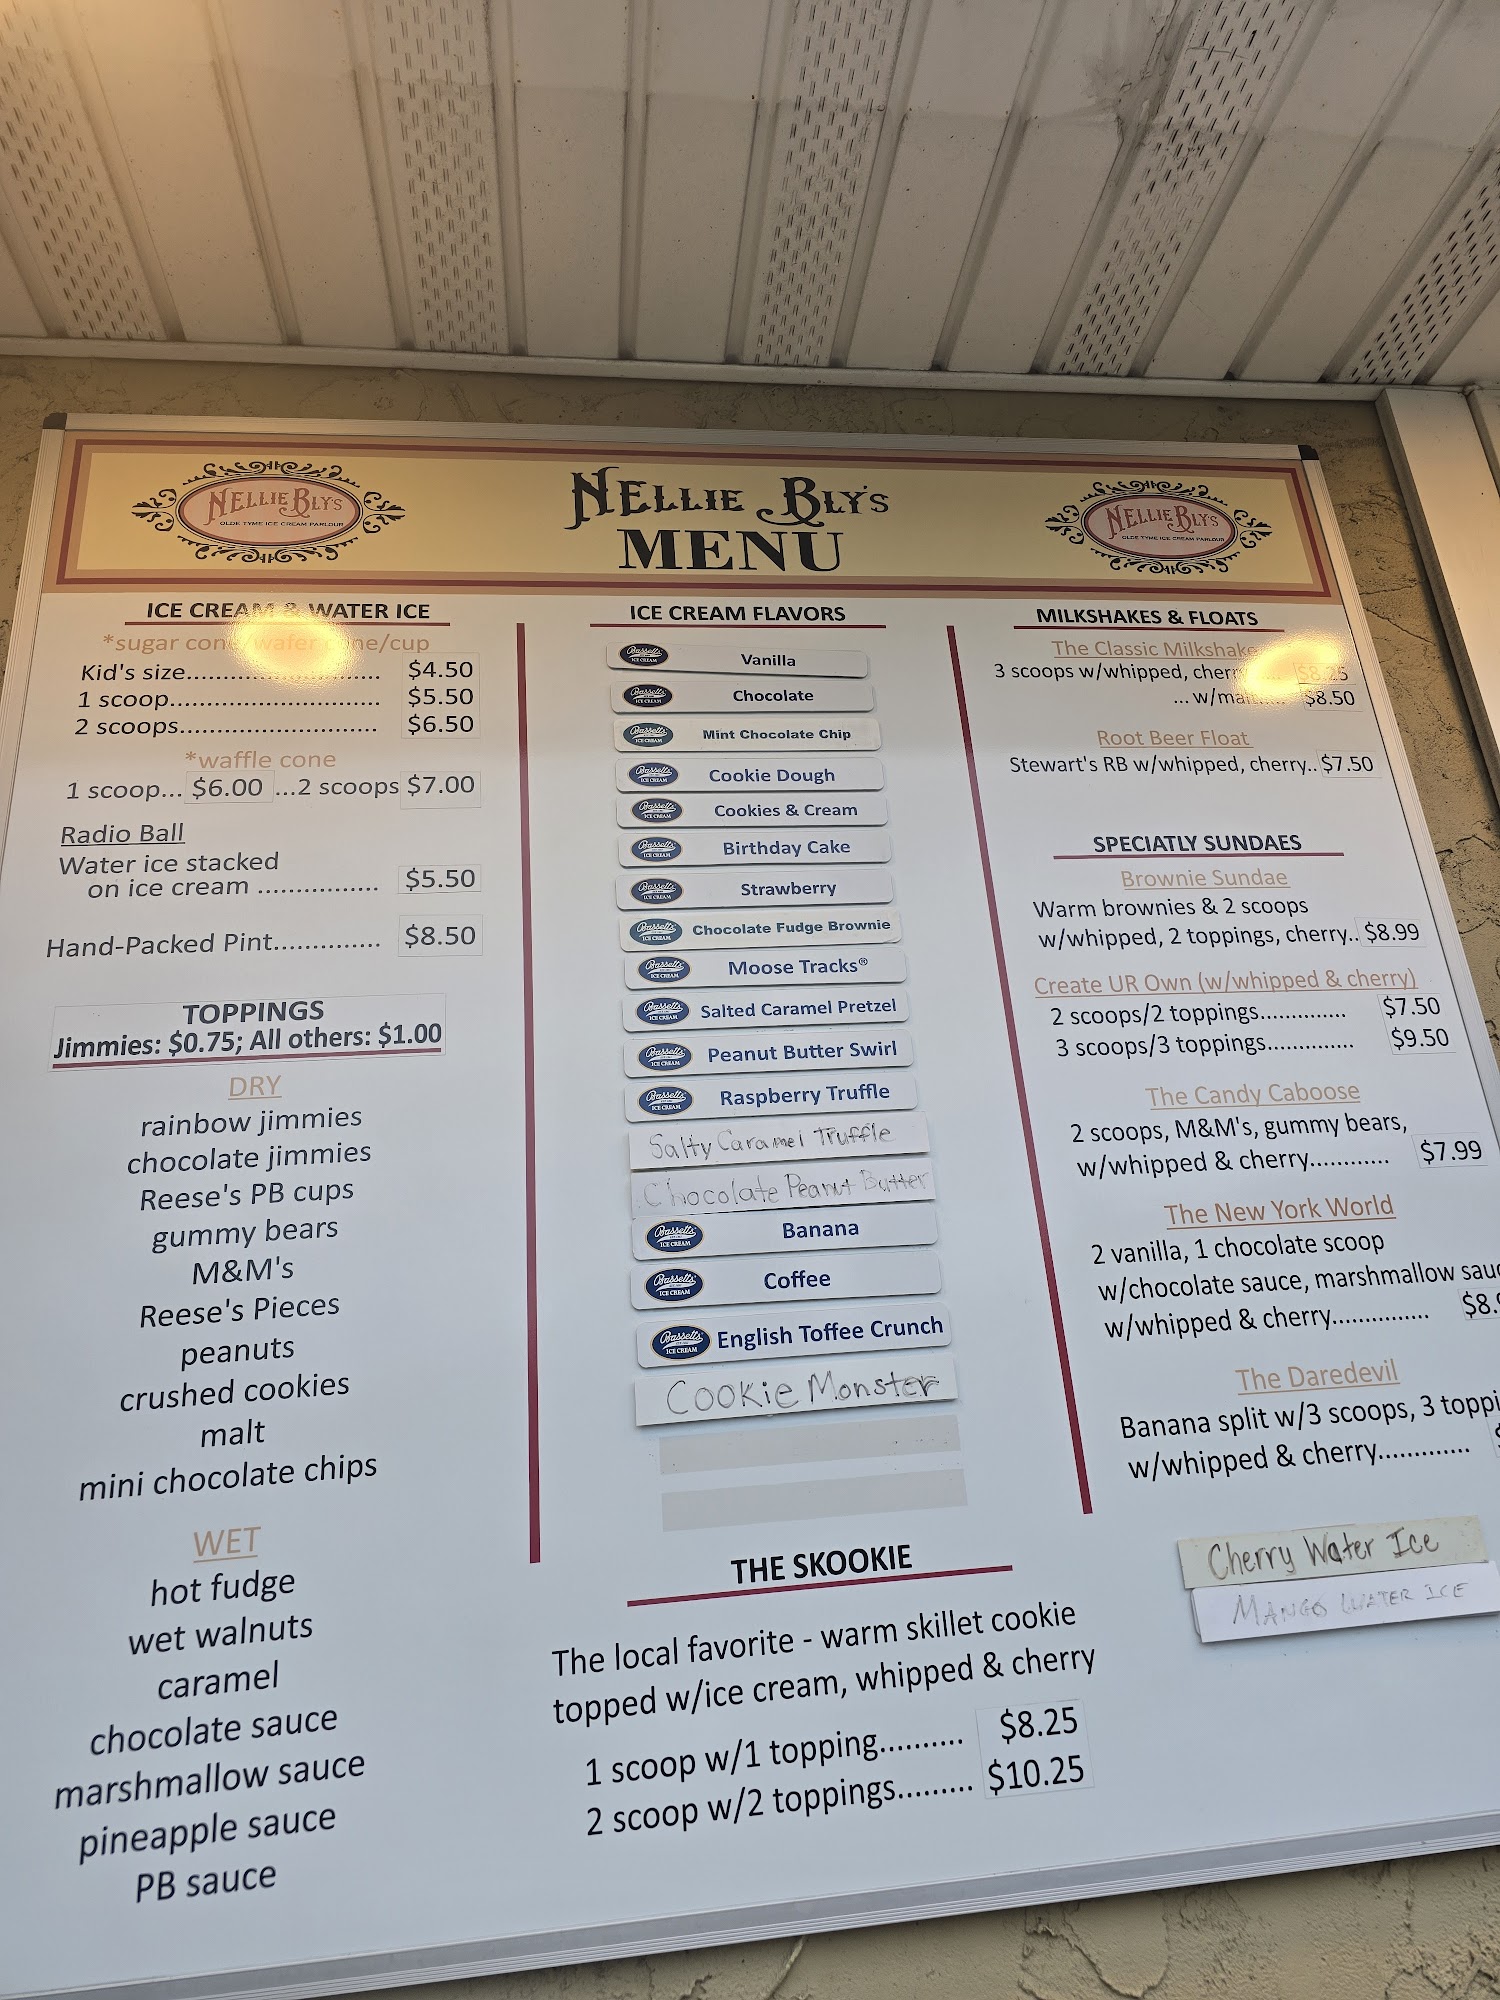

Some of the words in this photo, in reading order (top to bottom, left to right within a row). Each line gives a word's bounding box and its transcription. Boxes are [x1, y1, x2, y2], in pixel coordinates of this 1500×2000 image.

[617, 529, 844, 572] MENU
[146, 603, 184, 619] ICE
[189, 603, 275, 619] CREAM
[308, 603, 390, 619] WATER
[395, 603, 430, 619] ICE
[630, 605, 662, 620] ICE
[668, 605, 746, 621] CREAM
[753, 606, 846, 622] FLAVORS
[1036, 608, 1162, 624] MILKSHAKES
[1168, 610, 1184, 625] &
[1189, 610, 1258, 626] FLOATS
[407, 659, 474, 680] $4.50
[740, 653, 797, 667] Vanilla
[407, 686, 474, 708] $5.50
[732, 689, 814, 702] Chocolate
[407, 714, 475, 735] $6.50
[702, 729, 735, 740] Mint
[739, 729, 814, 740] Chocolate
[819, 729, 851, 740] Chip
[1097, 730, 1145, 747] Root
[1150, 730, 1195, 747] Beer
[1200, 730, 1250, 747] Float
[279, 753, 337, 769] cone
[708, 768, 771, 783] Cookie
[776, 768, 835, 786] Dough
[714, 803, 781, 817] Cookies
[785, 803, 799, 817] &
[803, 803, 858, 817] Cream
[60, 824, 131, 844] Radio
[139, 823, 185, 843] Ball
[1093, 836, 1197, 853] SPECIATLY
[1205, 835, 1302, 851] SUNDAES
[723, 840, 802, 858] Birthday
[807, 839, 851, 855] Cake
[405, 868, 476, 890] $5.50
[740, 881, 837, 897] Strawberry
[1121, 870, 1207, 888] Brownie
[1212, 869, 1288, 886] Sundae
[1033, 900, 1097, 918] Warm
[1102, 898, 1196, 916] brownies
[1202, 898, 1218, 915] &
[1224, 898, 1236, 915] 2
[1241, 898, 1309, 918] scoops
[404, 925, 477, 947] $8.50
[692, 923, 772, 936] Chocolate
[776, 921, 823, 935] Fudge
[828, 919, 891, 932] Brownie
[1364, 922, 1420, 942] $8.99
[728, 960, 794, 976] Moose
[184, 1000, 325, 1025] TOPPINGS
[700, 1003, 756, 1019] Salted
[760, 1000, 833, 1017] Caramel
[837, 998, 897, 1014] Pretzel
[1382, 996, 1441, 1017] $7.50
[53, 1035, 162, 1060] Jimmies:
[168, 1031, 243, 1057] $0.75;
[249, 1028, 282, 1051] All
[287, 1025, 371, 1049] others:
[377, 1022, 442, 1046] $1.00
[1391, 1028, 1450, 1049] $9.50
[707, 1045, 778, 1064] Peanut
[783, 1043, 844, 1061] Butter
[849, 1041, 898, 1057] Swirl
[228, 1075, 282, 1098] DRY
[720, 1088, 821, 1108] Raspberry
[825, 1083, 890, 1102] Truffle
[1145, 1086, 1188, 1108] The
[1194, 1085, 1262, 1108] Candy
[1267, 1082, 1360, 1103] Caboose
[140, 1112, 251, 1138] rainbow
[256, 1107, 363, 1136] jimmies
[648, 1132, 712, 1160] Salty
[717, 1128, 805, 1152] Caramel
[813, 1122, 897, 1146] Truffle
[127, 1147, 260, 1175] chocolate
[264, 1142, 372, 1172] jimmies
[139, 1184, 241, 1211] Reese's
[250, 1182, 285, 1205] PB
[293, 1181, 355, 1206] cups
[643, 1174, 780, 1209] Chocolate
[784, 1173, 856, 1199] Peanut
[860, 1169, 929, 1192] Butter
[1164, 1204, 1208, 1227] The
[1215, 1202, 1266, 1223] New
[1270, 1199, 1320, 1220] York
[1325, 1194, 1395, 1217] World
[782, 1221, 860, 1239] Banana
[191, 1257, 295, 1285] M&M's
[763, 1271, 832, 1290] Coffee
[717, 1326, 793, 1351] English
[798, 1322, 864, 1343] Toffee
[870, 1316, 944, 1338] Crunch
[180, 1337, 295, 1372] peanuts
[1235, 1367, 1281, 1392] The
[1288, 1358, 1399, 1388] Daredevil
[119, 1379, 234, 1413] crushed
[244, 1373, 350, 1405] cookies
[666, 1380, 798, 1415] Cookie
[808, 1370, 940, 1406] Monster
[200, 1419, 266, 1448] malt
[79, 1471, 144, 1502] mini
[152, 1461, 295, 1496] chocolate
[304, 1454, 378, 1483] chips
[193, 1526, 261, 1557] WET
[731, 1557, 785, 1585] THE
[793, 1544, 913, 1580] SKOOKIE
[1206, 1543, 1295, 1581] Cherry
[1303, 1534, 1374, 1567] Water
[1386, 1526, 1439, 1557] Ice
[150, 1578, 202, 1607] hot
[211, 1569, 296, 1602] fudge
[1424, 1582, 1468, 1600] ICE
[128, 1626, 185, 1655] wet
[195, 1615, 314, 1649] walnuts
[552, 1649, 605, 1677] The
[614, 1637, 679, 1671] local
[688, 1629, 794, 1665] favorite
[821, 1618, 898, 1649] warm
[906, 1609, 984, 1640] skillet
[991, 1601, 1077, 1633] cookie
[157, 1660, 280, 1700] caramel
[54, 1762, 270, 1810] marshmallow
[278, 1755, 366, 1786] sauce
[136, 1871, 176, 1903] PB
[186, 1865, 277, 1898] sauce
